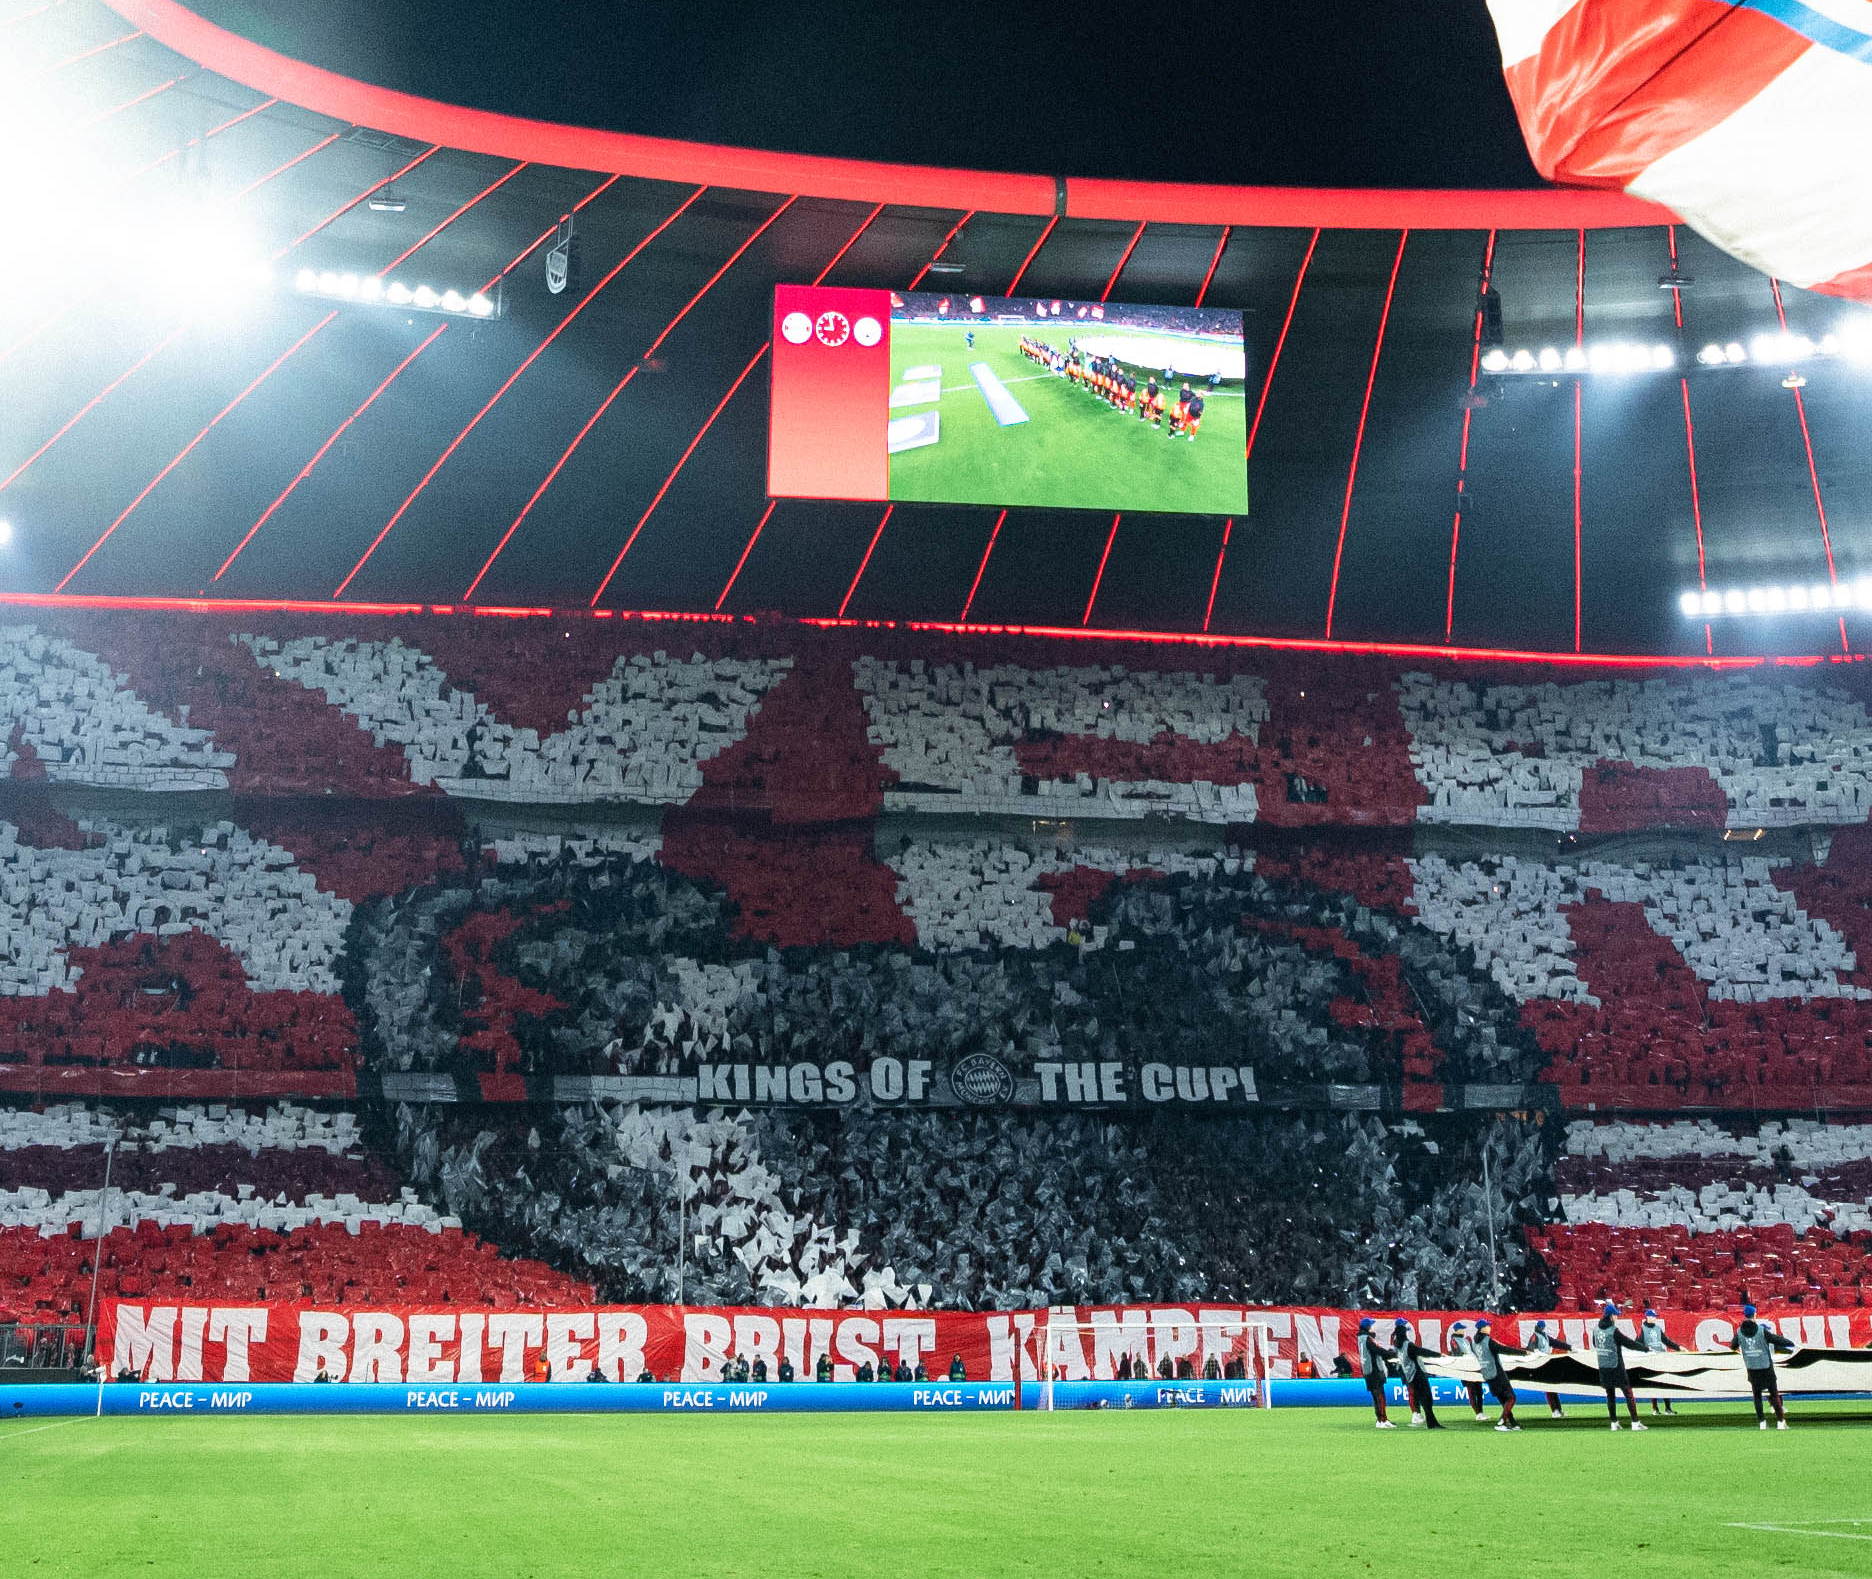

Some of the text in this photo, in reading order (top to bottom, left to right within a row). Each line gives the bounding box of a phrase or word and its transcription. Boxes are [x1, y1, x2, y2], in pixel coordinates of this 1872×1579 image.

[699, 1056, 1261, 1104] KINGS OF THE CUP!
[112, 1304, 268, 1381] MIT
[293, 1310, 649, 1383] BREITER
[683, 1313, 936, 1383] BRUST
[987, 1305, 1341, 1381] KÄMPFEN
[139, 1391, 193, 1409] PEACE
[406, 1391, 460, 1408] PEACE
[663, 1391, 715, 1407] PEACE
[913, 1389, 962, 1406] PEACE
[1393, 1386, 1440, 1402] PEE
